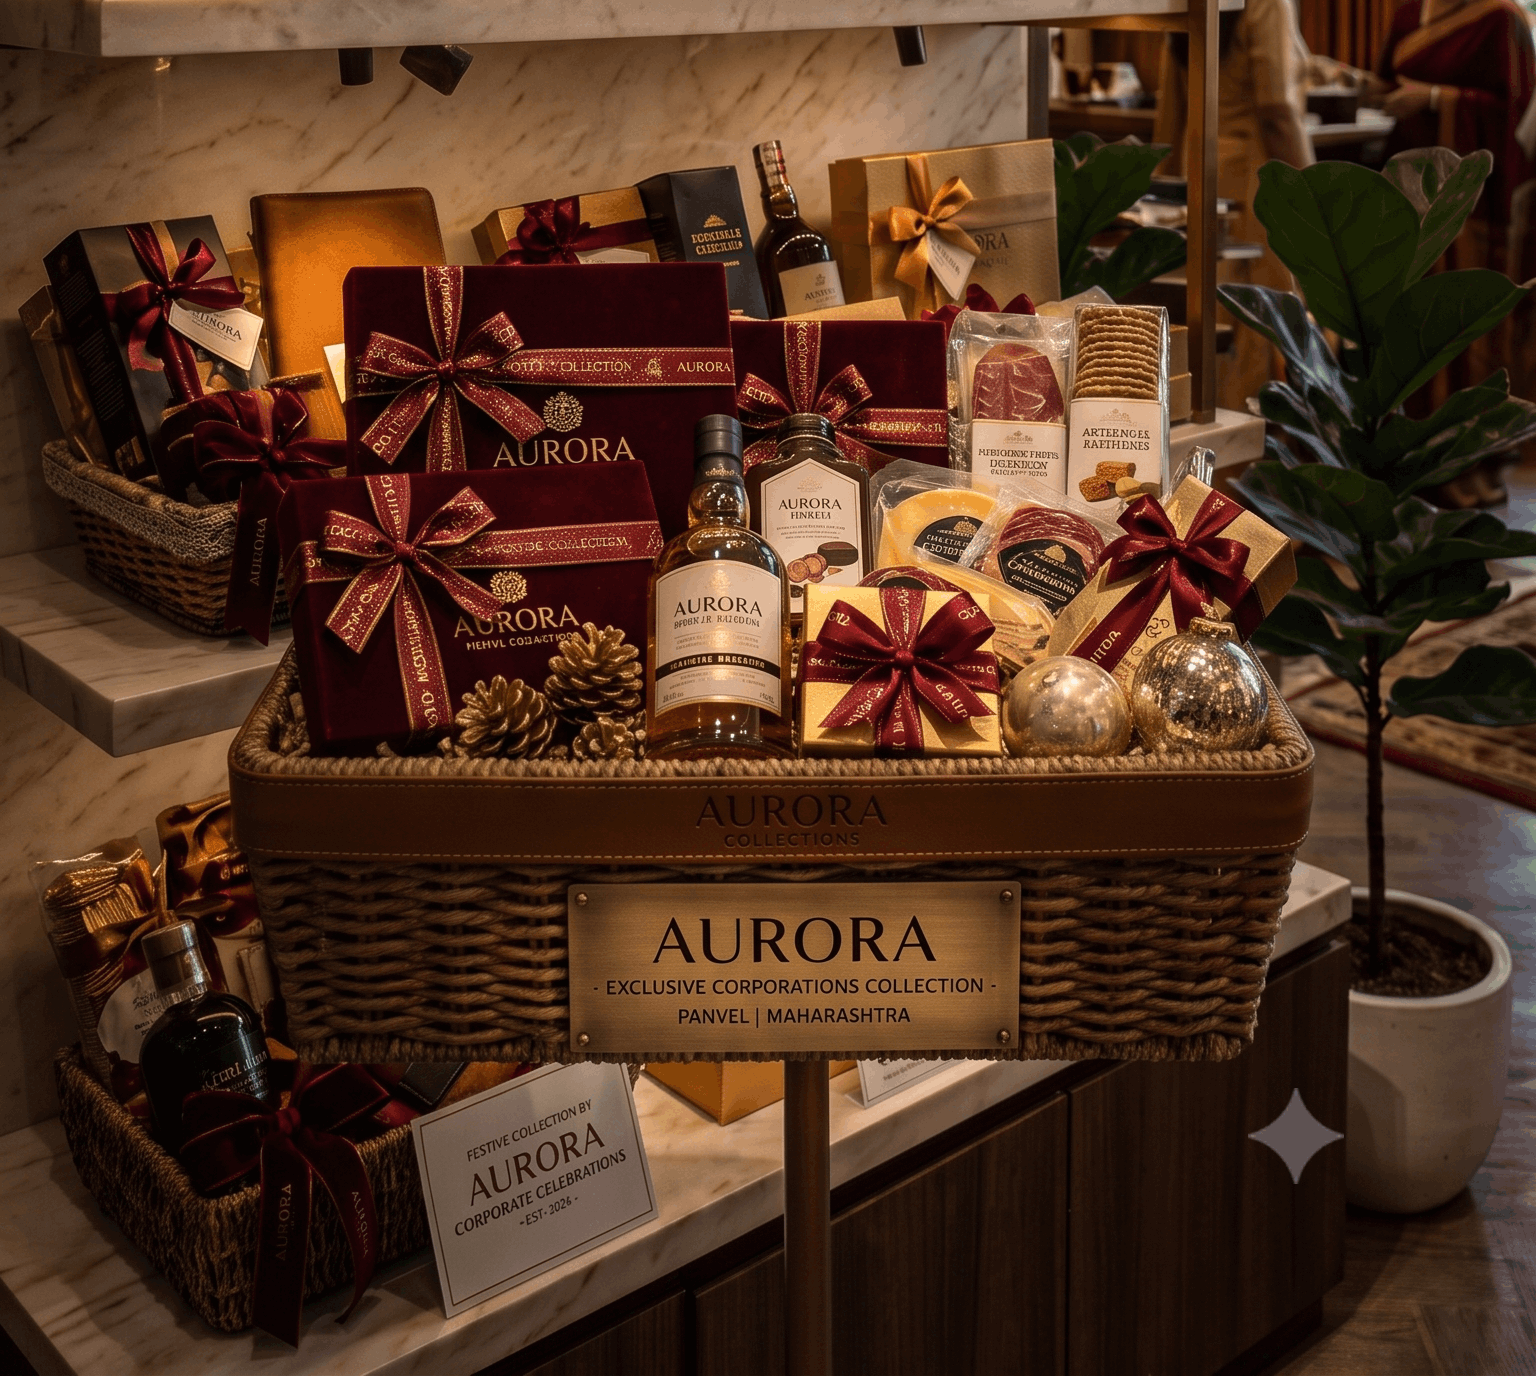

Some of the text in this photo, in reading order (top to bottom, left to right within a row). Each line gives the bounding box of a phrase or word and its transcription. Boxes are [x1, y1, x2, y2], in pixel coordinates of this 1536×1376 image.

[677, 361, 732, 373] AURORA
[493, 435, 637, 469] AURORA
[778, 497, 842, 511] AURORA
[673, 595, 763, 618] AURORA
[454, 604, 580, 638] AURORA
[695, 794, 888, 828] AURORA
[724, 832, 860, 849] COLLECTIONS
[652, 914, 937, 964] AURORA
[606, 979, 706, 995] EXCLUSIVE
[712, 979, 859, 995] CORPORATIONS
[865, 978, 984, 994] COLLECTION
[678, 1008, 750, 1024] PANVEL
[767, 1007, 911, 1024] MAHARASHTRA
[466, 1099, 592, 1162] FESTIVE COLLECTION BY
[470, 1122, 606, 1207] AURORA
[454, 1148, 627, 1237] CORPORATE CELEBRATIONS
[549, 1196, 573, 1216] 2026
